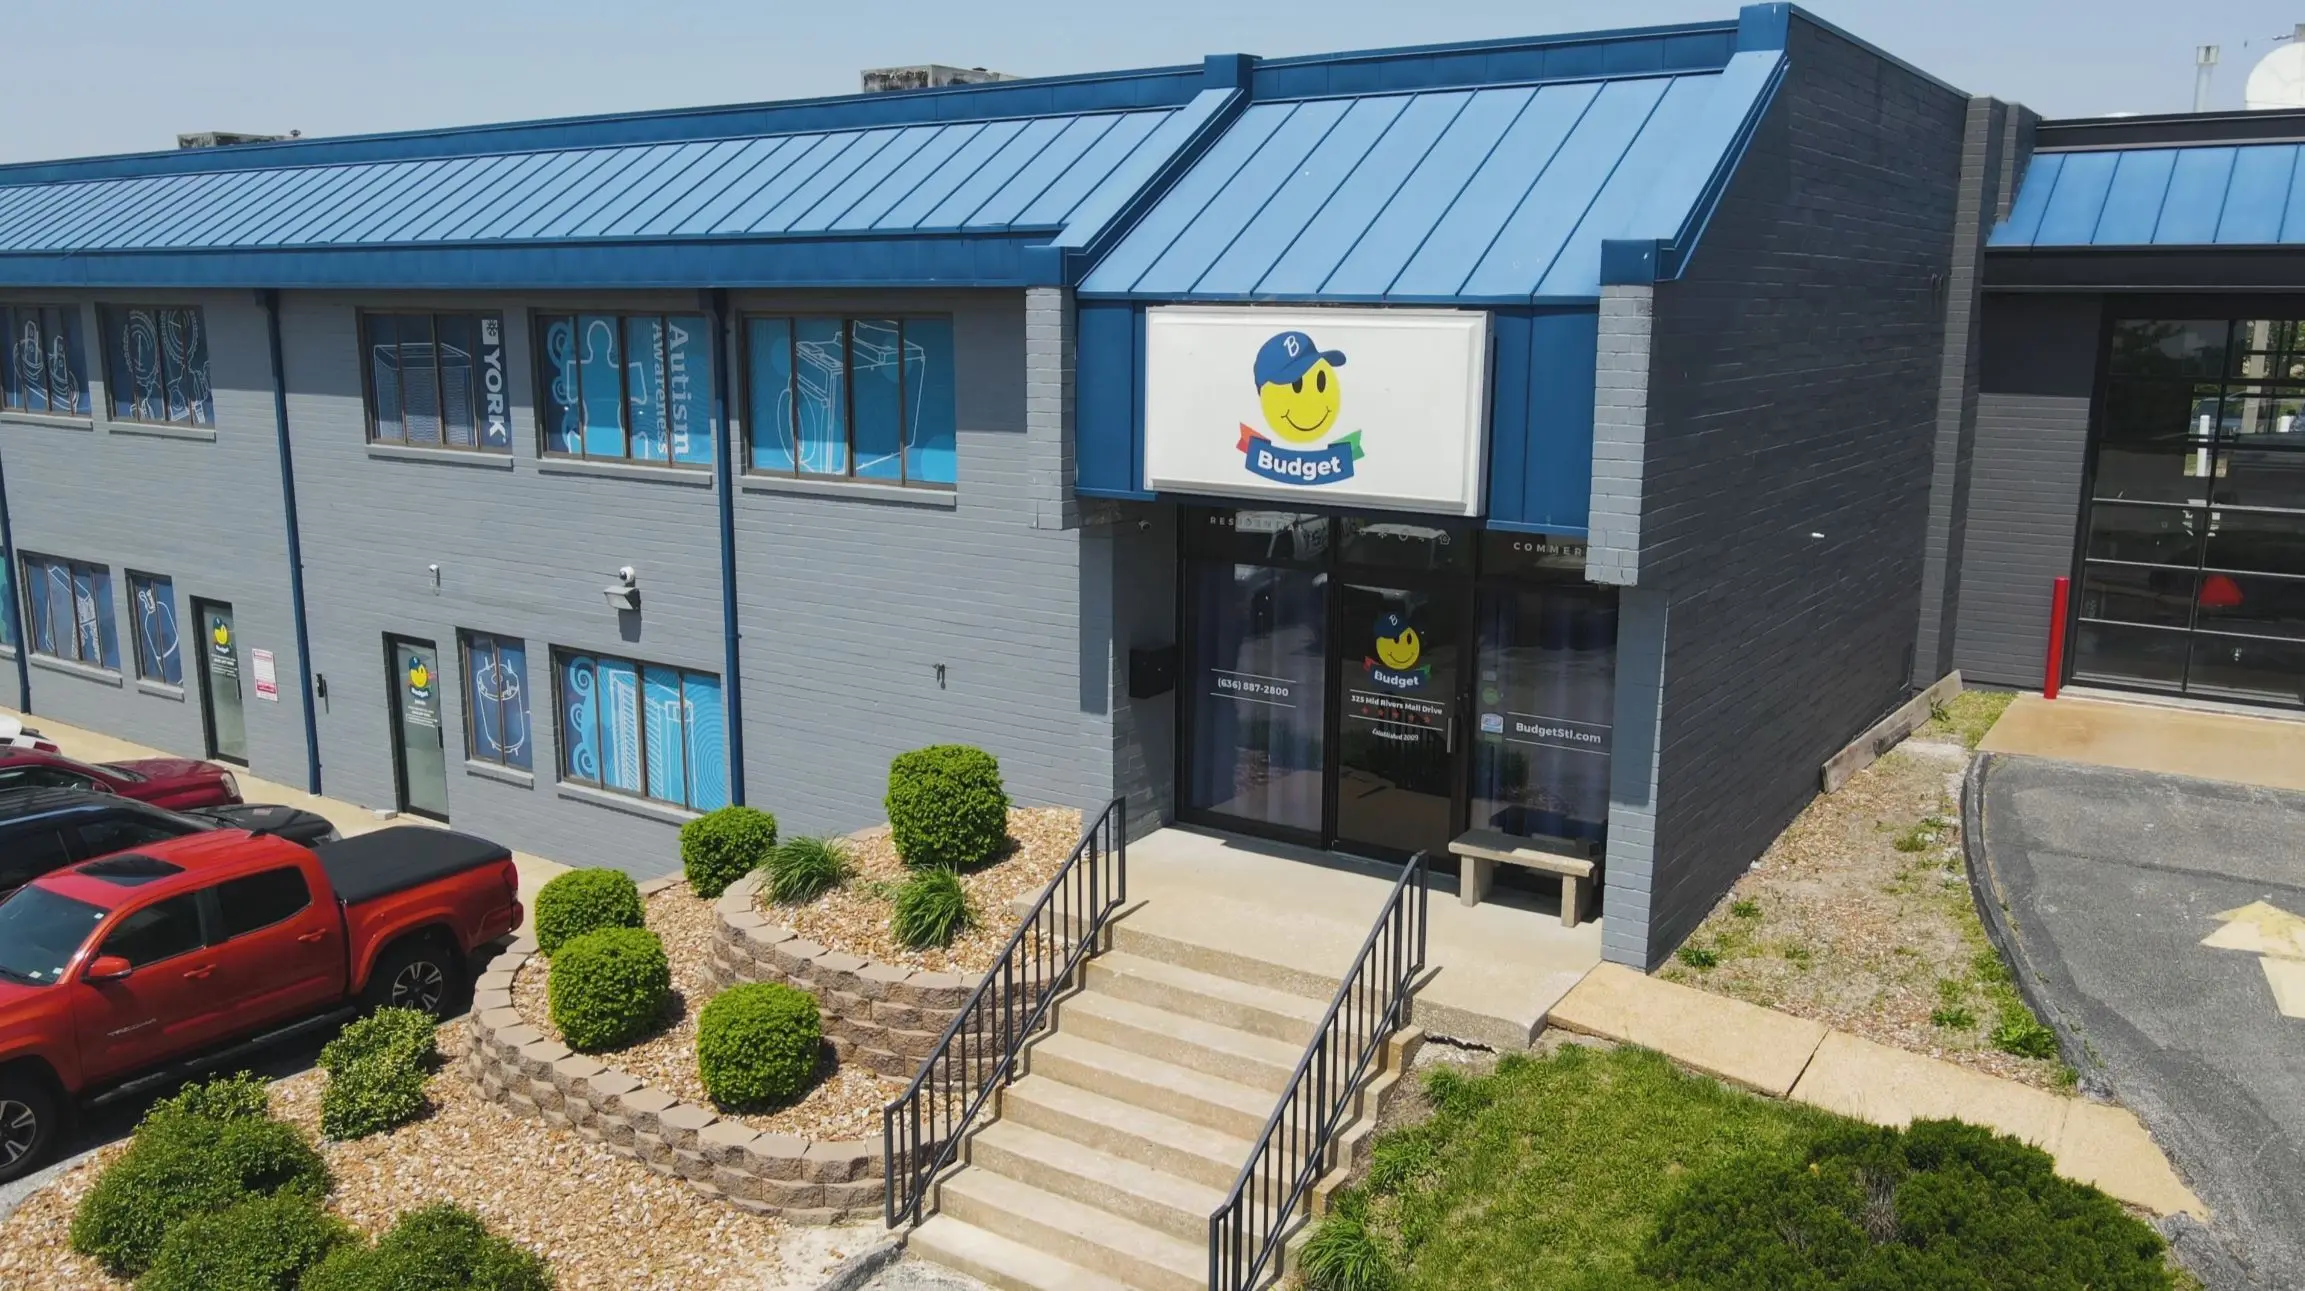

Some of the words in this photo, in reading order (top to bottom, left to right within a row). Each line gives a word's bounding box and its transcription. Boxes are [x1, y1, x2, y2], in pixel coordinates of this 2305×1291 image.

[1283, 335, 1300, 357] B
[483, 347, 507, 438] YORK
[652, 321, 668, 454] Awareness
[668, 322, 692, 455] Autism
[1257, 449, 1342, 481] Budget
[1512, 542, 1583, 557] COMMER
[1217, 677, 1242, 691] (636)
[1374, 670, 1420, 688] Budget
[1365, 697, 1379, 705] Mid
[1380, 699, 1403, 709] Rivers
[1404, 703, 1420, 711] Mall
[1422, 705, 1443, 715] Drive
